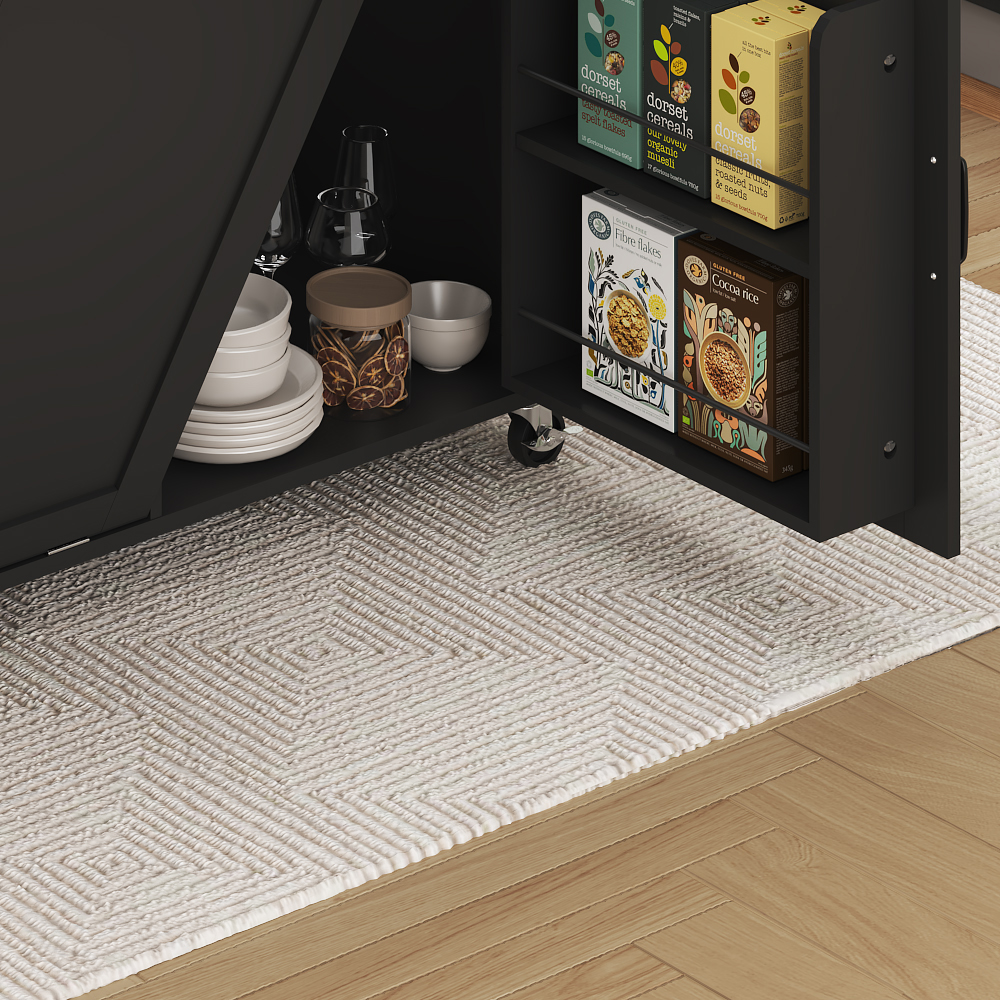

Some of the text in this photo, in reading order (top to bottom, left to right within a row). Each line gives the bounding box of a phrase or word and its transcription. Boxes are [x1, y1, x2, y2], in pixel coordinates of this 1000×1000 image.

[581, 64, 622, 93] dorset
[582, 84, 627, 110] cereals
[647, 92, 688, 122] dorset
[582, 99, 632, 128] tasty toasted
[582, 112, 625, 137] spelt flakes
[647, 111, 694, 140] cereals
[647, 139, 678, 158] organic
[648, 128, 687, 152] our lovely
[715, 121, 757, 152] dorset
[647, 150, 675, 169] muesli
[715, 141, 762, 170] cereals
[716, 169, 768, 198] roasted nuts
[716, 179, 748, 201] & seeds
[616, 218, 647, 235] GLUTEN FREE
[616, 228, 662, 259] Fibre flakes
[713, 263, 745, 281] GLUTEN FREE
[712, 274, 759, 305] Cocoa rice
